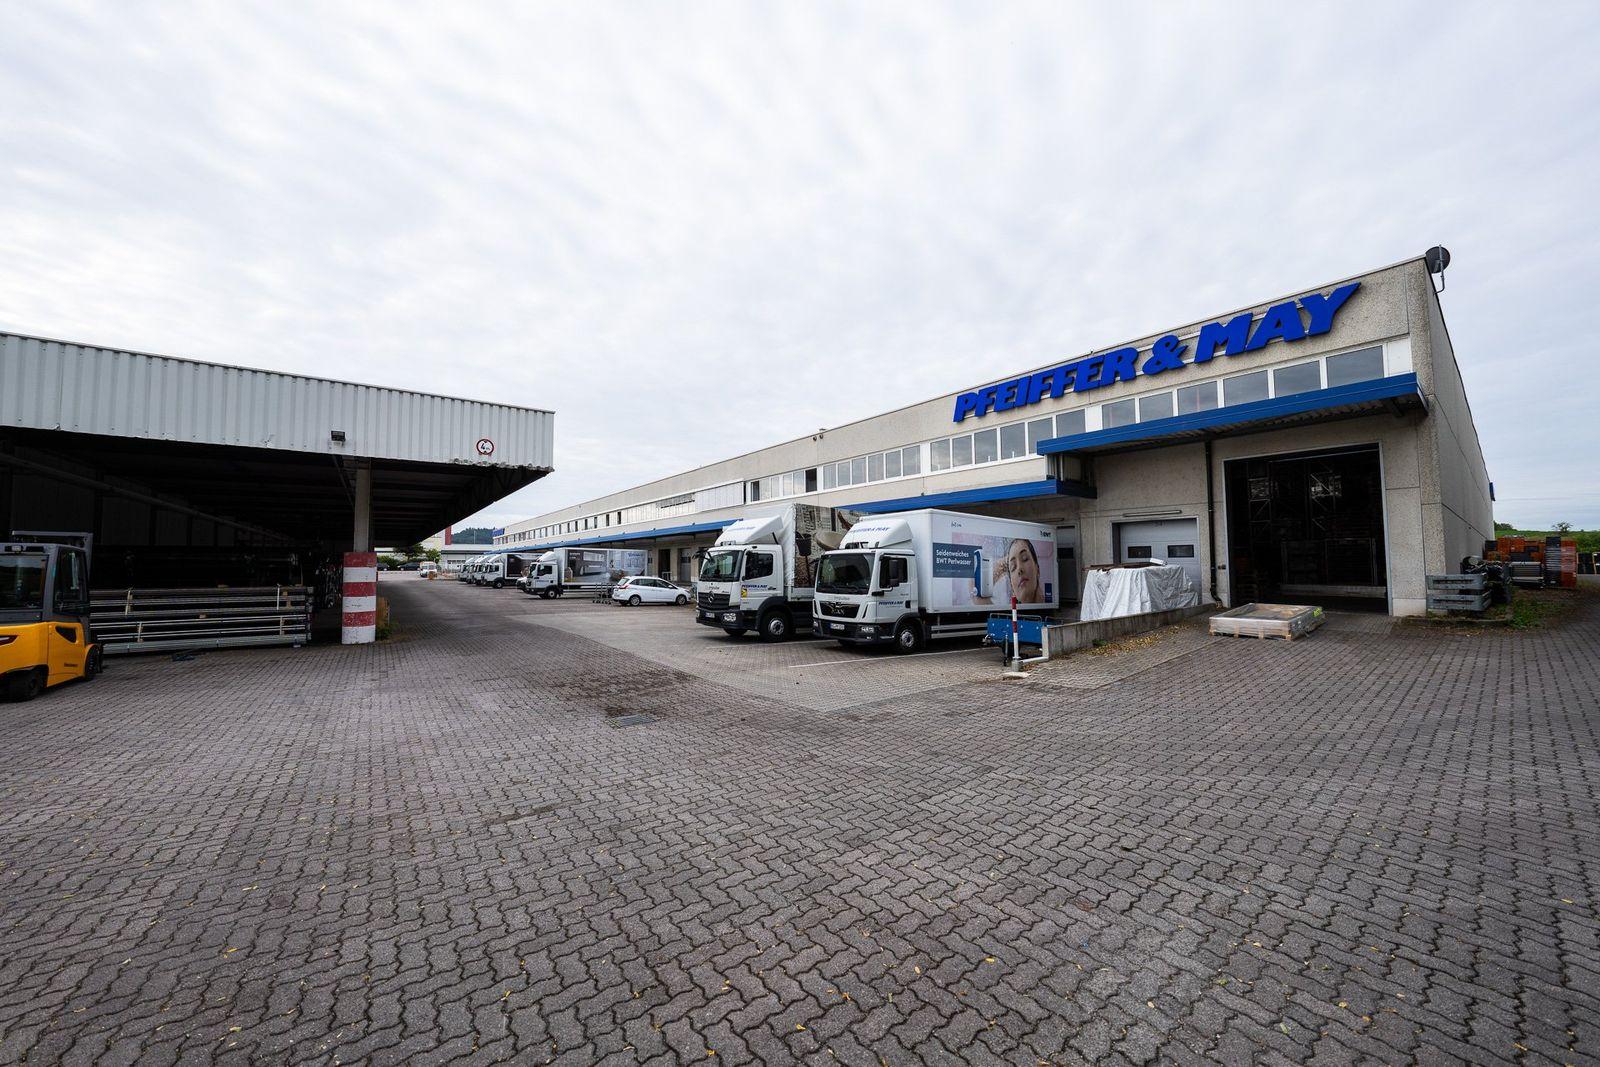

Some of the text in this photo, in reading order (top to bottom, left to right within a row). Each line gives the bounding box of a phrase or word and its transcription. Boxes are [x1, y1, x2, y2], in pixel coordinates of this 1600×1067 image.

[953, 282, 1362, 423] PFEIFFER & MAY
[936, 549, 969, 558] Seidenweiches
[948, 558, 972, 566] Perlwasser
